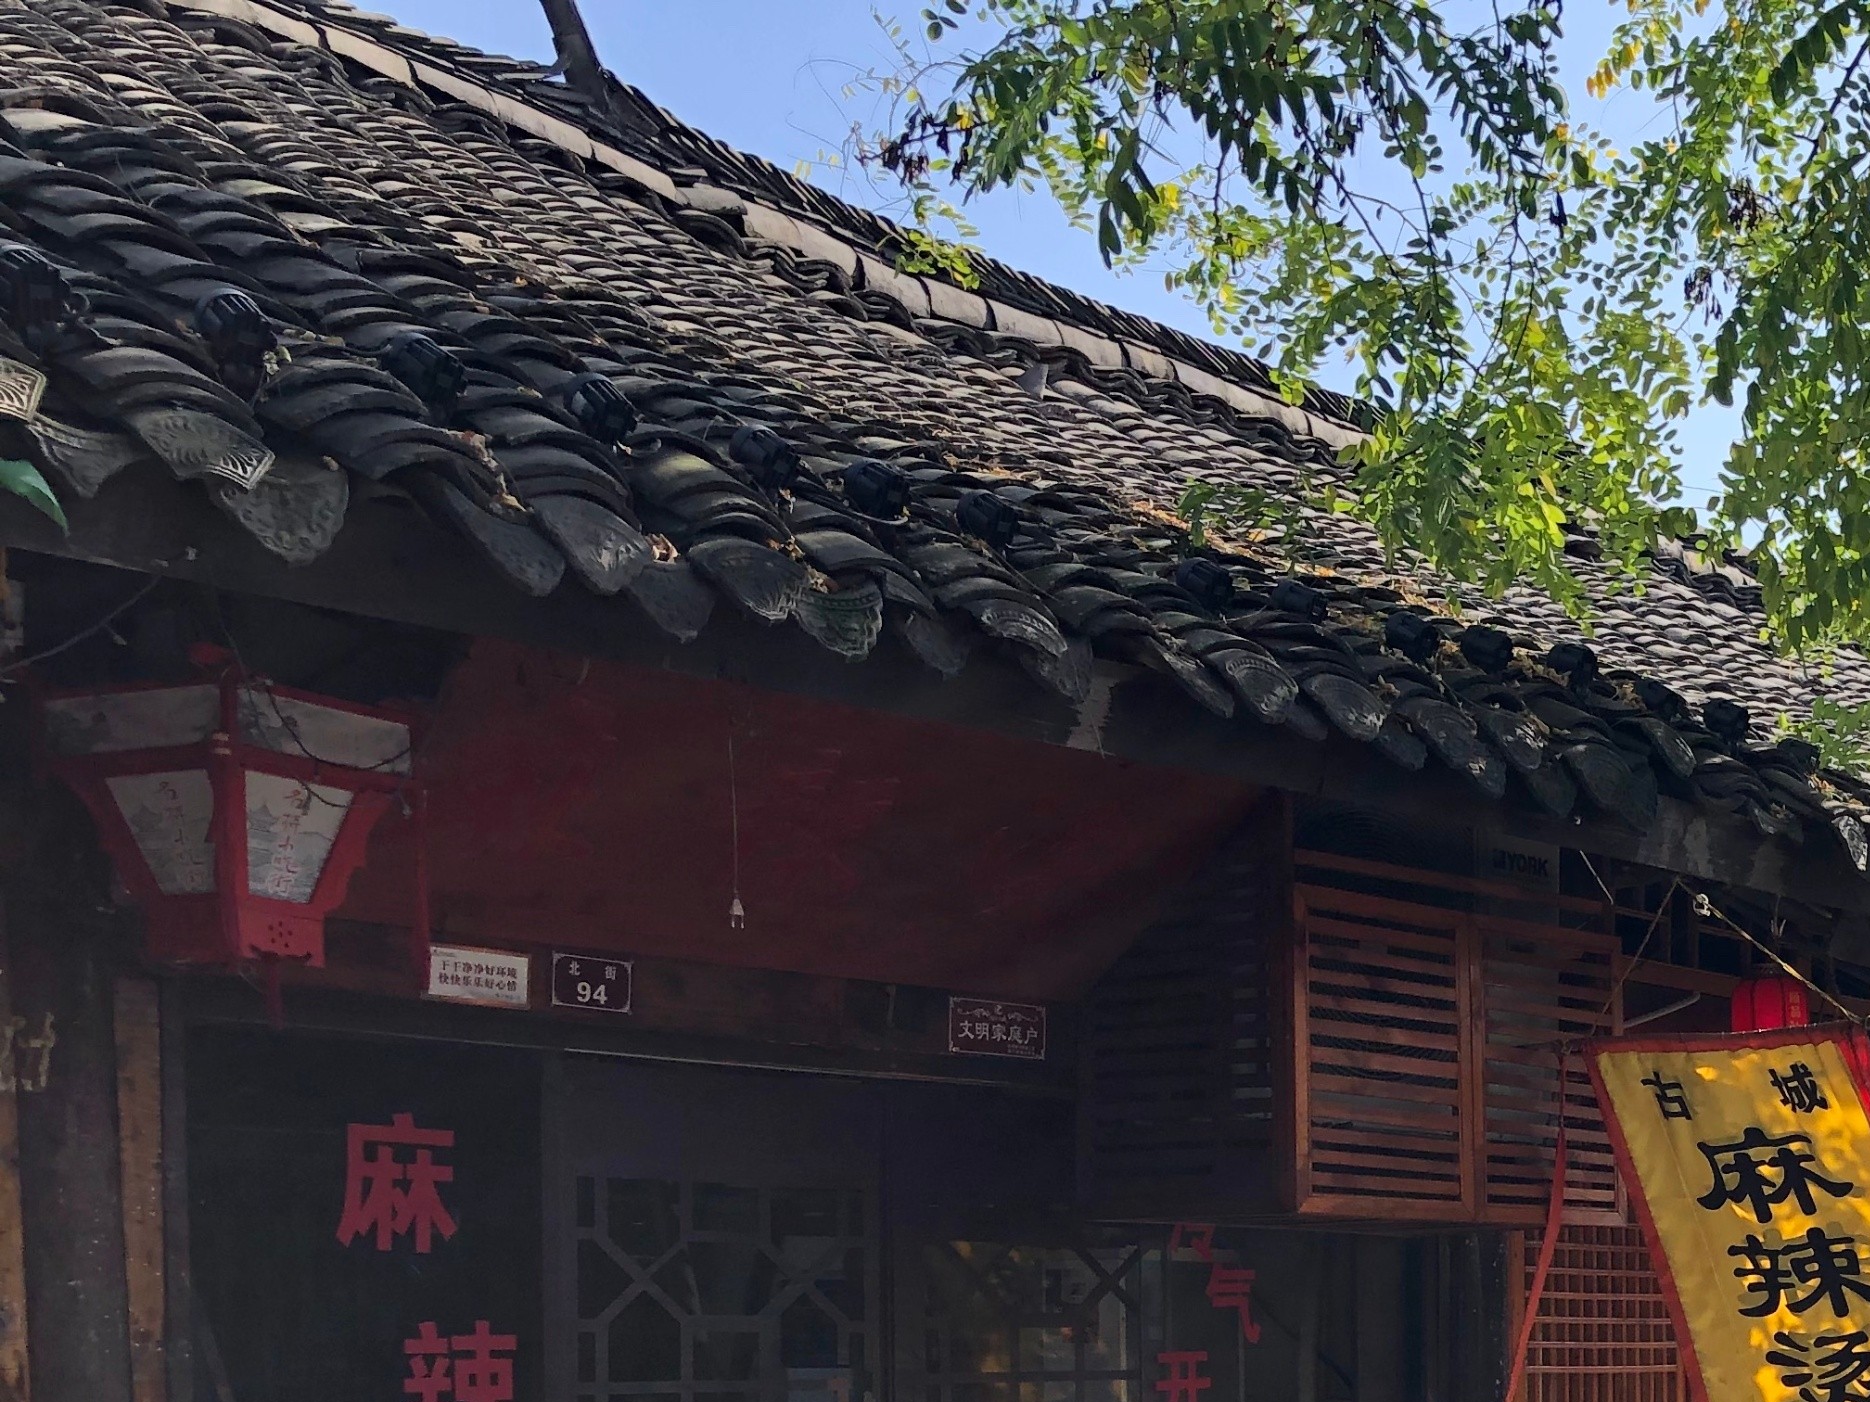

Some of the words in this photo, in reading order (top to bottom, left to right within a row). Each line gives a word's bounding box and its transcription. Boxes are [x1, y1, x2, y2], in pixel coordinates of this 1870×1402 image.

[441, 961, 518, 979] 干干净净好环境
[568, 961, 617, 981] 北街
[439, 972, 517, 991] 快快乐乐好心情
[577, 982, 608, 1004] 94
[958, 1021, 1038, 1044] 文明家庭户
[1641, 1062, 1829, 1122] 古城
